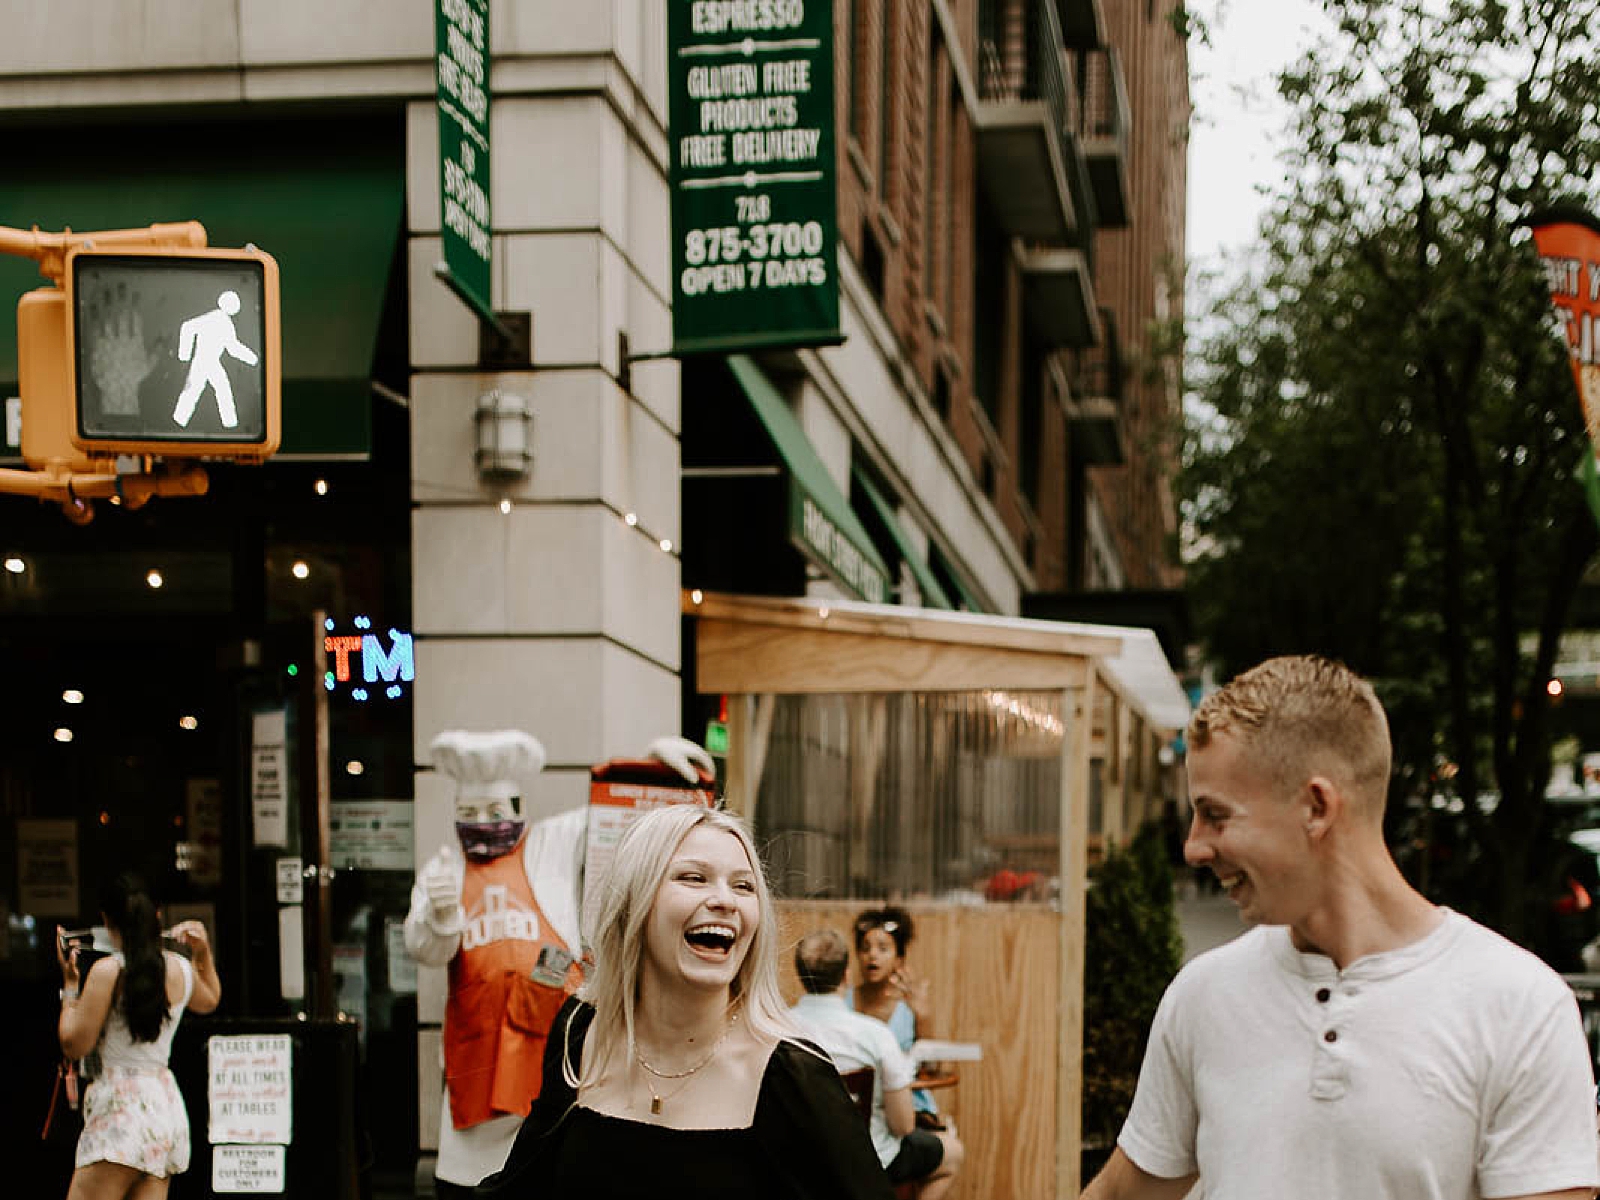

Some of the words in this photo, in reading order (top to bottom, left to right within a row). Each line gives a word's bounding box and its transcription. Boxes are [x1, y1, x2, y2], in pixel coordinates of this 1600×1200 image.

[692, 0, 805, 33] ESPRESSO
[687, 63, 758, 99] GLUTEN
[763, 60, 811, 93] FREE
[701, 96, 798, 132] PRODUCTS
[680, 134, 727, 168] FREE
[732, 128, 821, 164] DELIVERY
[735, 194, 771, 223] 718
[685, 221, 824, 265] 875-3700
[681, 263, 746, 296] OPEN
[747, 261, 763, 289] 7
[765, 257, 827, 288] DAYS
[213, 1041, 253, 1054] PLEASE
[221, 1102, 234, 1116] AT
[238, 1102, 277, 1116] TABLES
